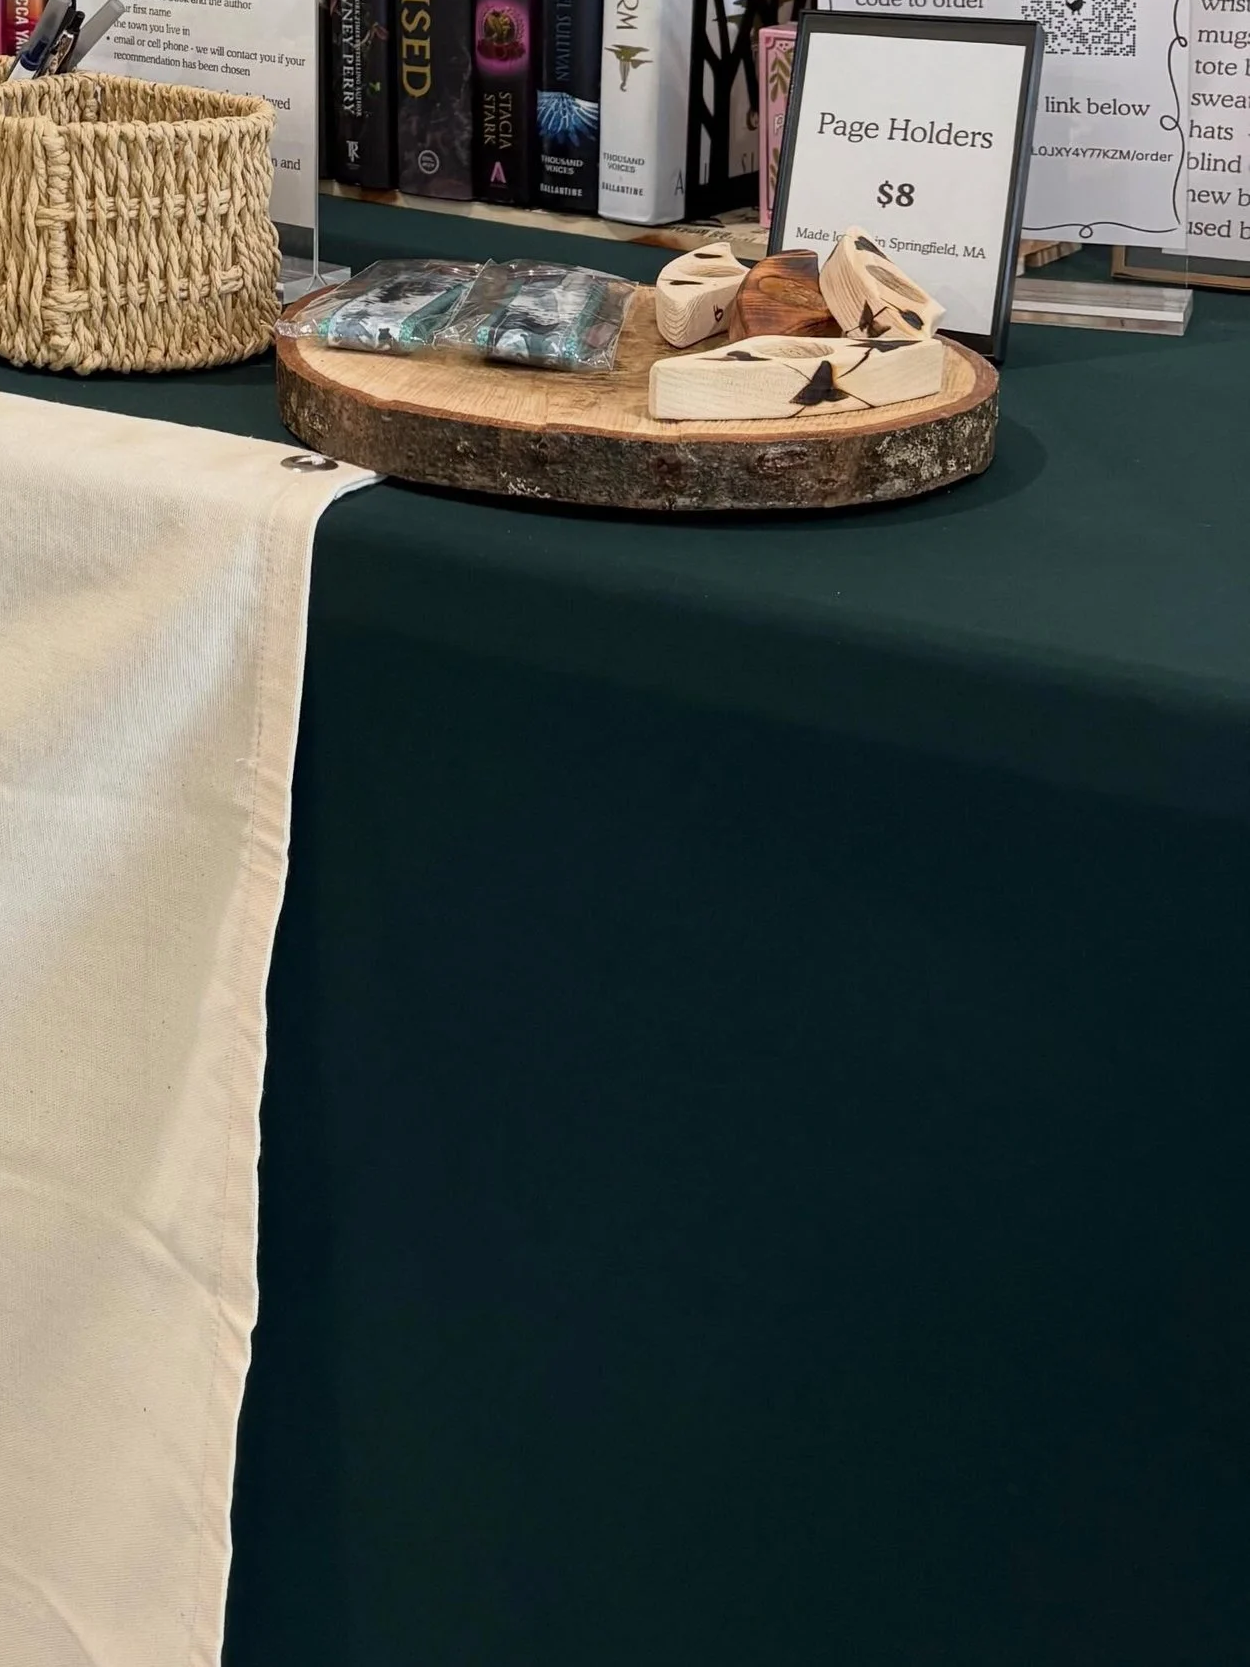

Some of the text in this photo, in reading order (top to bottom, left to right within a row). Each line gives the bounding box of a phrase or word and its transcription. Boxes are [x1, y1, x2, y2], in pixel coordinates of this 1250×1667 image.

[1044, 96, 1151, 118] link below
[817, 112, 994, 151] Page Holders
[876, 180, 916, 209] $8
[888, 236, 987, 261] Springfield, MA
